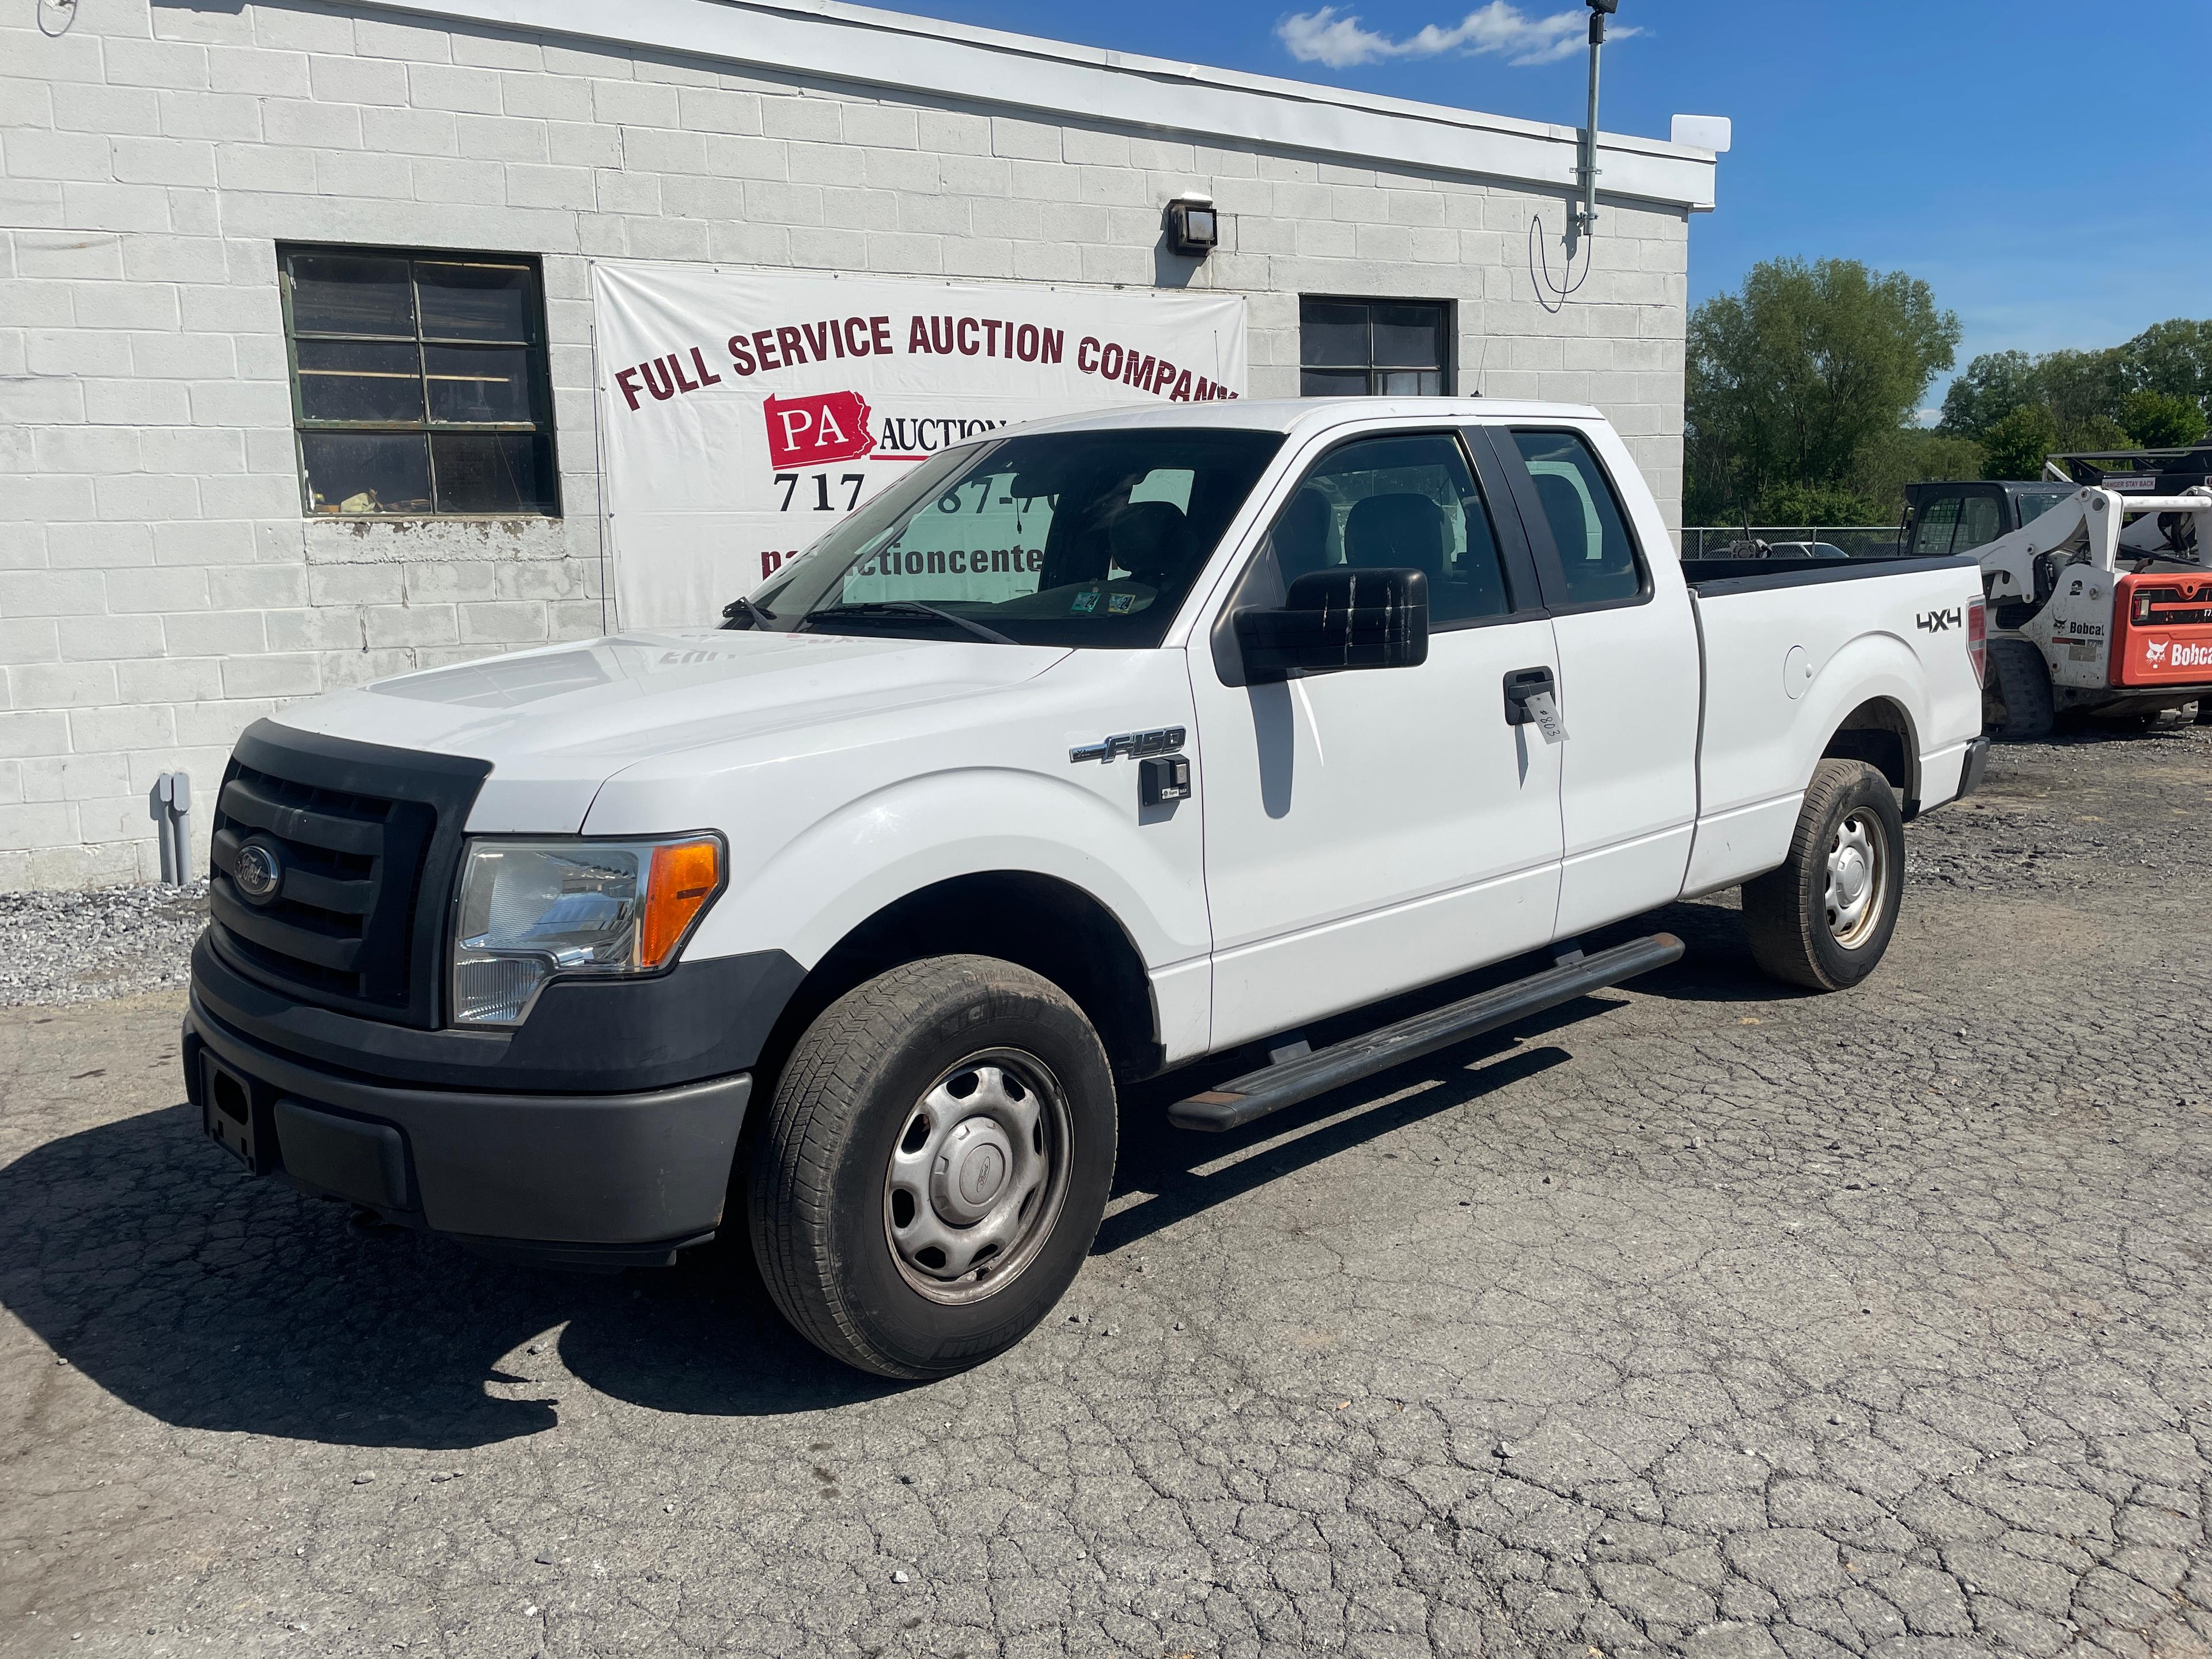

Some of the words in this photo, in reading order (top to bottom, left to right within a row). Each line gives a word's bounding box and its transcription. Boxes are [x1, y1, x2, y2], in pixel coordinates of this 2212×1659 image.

[615, 346, 721, 411] FULL
[728, 316, 894, 376] SERVICE
[908, 315, 1065, 364] AUCTION
[777, 404, 849, 452] PA
[773, 474, 865, 512] 717
[237, 852, 265, 885] Ford
